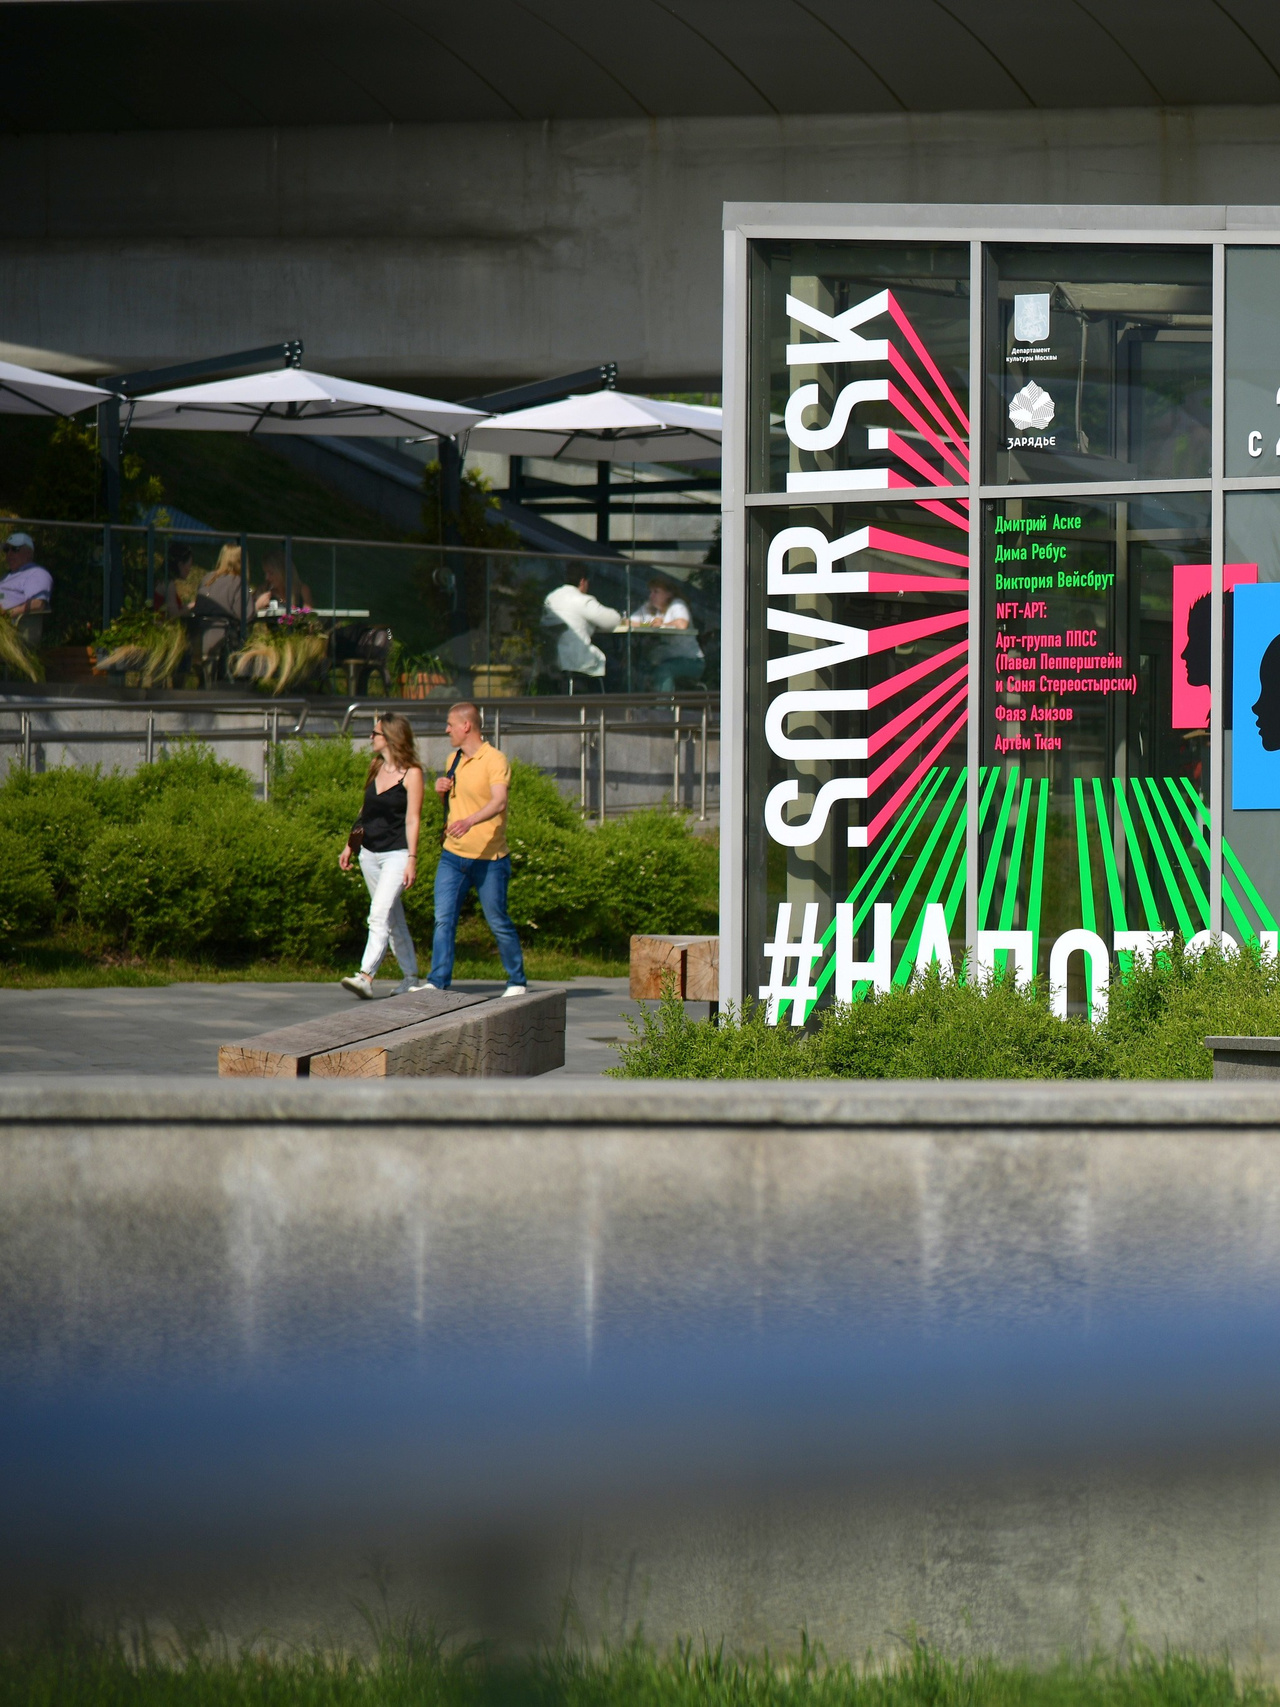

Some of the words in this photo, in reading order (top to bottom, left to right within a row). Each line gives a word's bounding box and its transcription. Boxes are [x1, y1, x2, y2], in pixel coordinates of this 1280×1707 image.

[1006, 355, 1034, 363] культуры
[1011, 347, 1051, 355] Департамент
[1247, 430, 1263, 458] с
[994, 514, 1047, 536] Дмитрий
[1052, 513, 1082, 530] Аске
[994, 544, 1027, 564] Дима
[1031, 543, 1067, 563] Ребус
[995, 573, 1053, 593] Виктория
[1057, 571, 1115, 591] Вейсбрут
[995, 632, 1062, 652] Арт-группа
[1065, 630, 1098, 648] ППСС
[995, 654, 1036, 674] (Павел
[1040, 652, 1123, 673] Пепперштейн
[995, 682, 1003, 693] и
[1006, 676, 1036, 693] Соня
[1039, 674, 1137, 696] Стереостырски)
[995, 706, 1027, 722] Фаяз
[1030, 705, 1073, 722] Азизов
[994, 734, 1031, 754] Артём
[1034, 733, 1062, 750] Ткач
